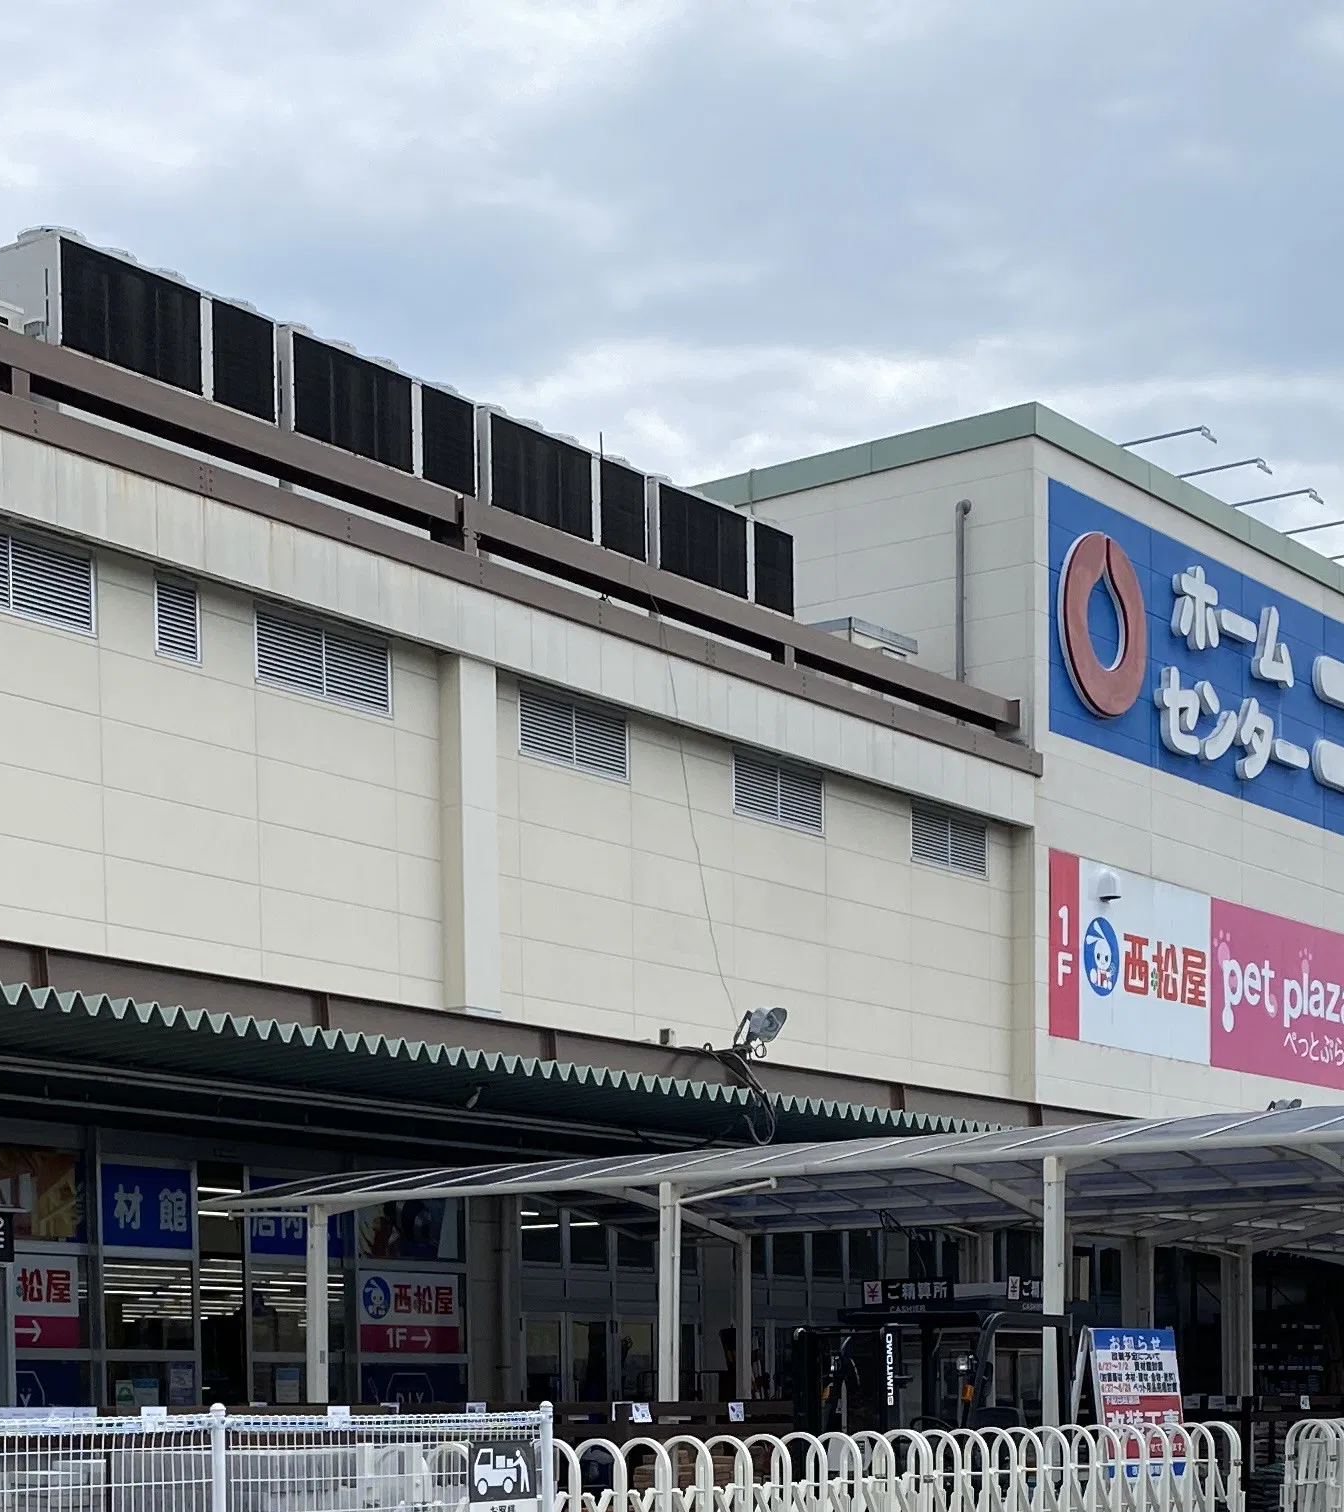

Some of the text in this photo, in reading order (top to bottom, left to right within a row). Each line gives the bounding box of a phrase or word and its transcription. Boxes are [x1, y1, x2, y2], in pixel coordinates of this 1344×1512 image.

[1171, 565, 1294, 689] ホーム
[1154, 666, 1310, 780] センター
[1058, 905, 1073, 987] 1F
[1123, 933, 1206, 1008] 西松屋
[1222, 959, 1276, 1033] pet
[393, 1284, 453, 1315] 西松屋
[887, 1280, 947, 1300] ご精算所
[386, 1327, 407, 1349] 1F
[885, 1333, 894, 1406] SUMITOMO
[1109, 1335, 1161, 1350] お知らせ
